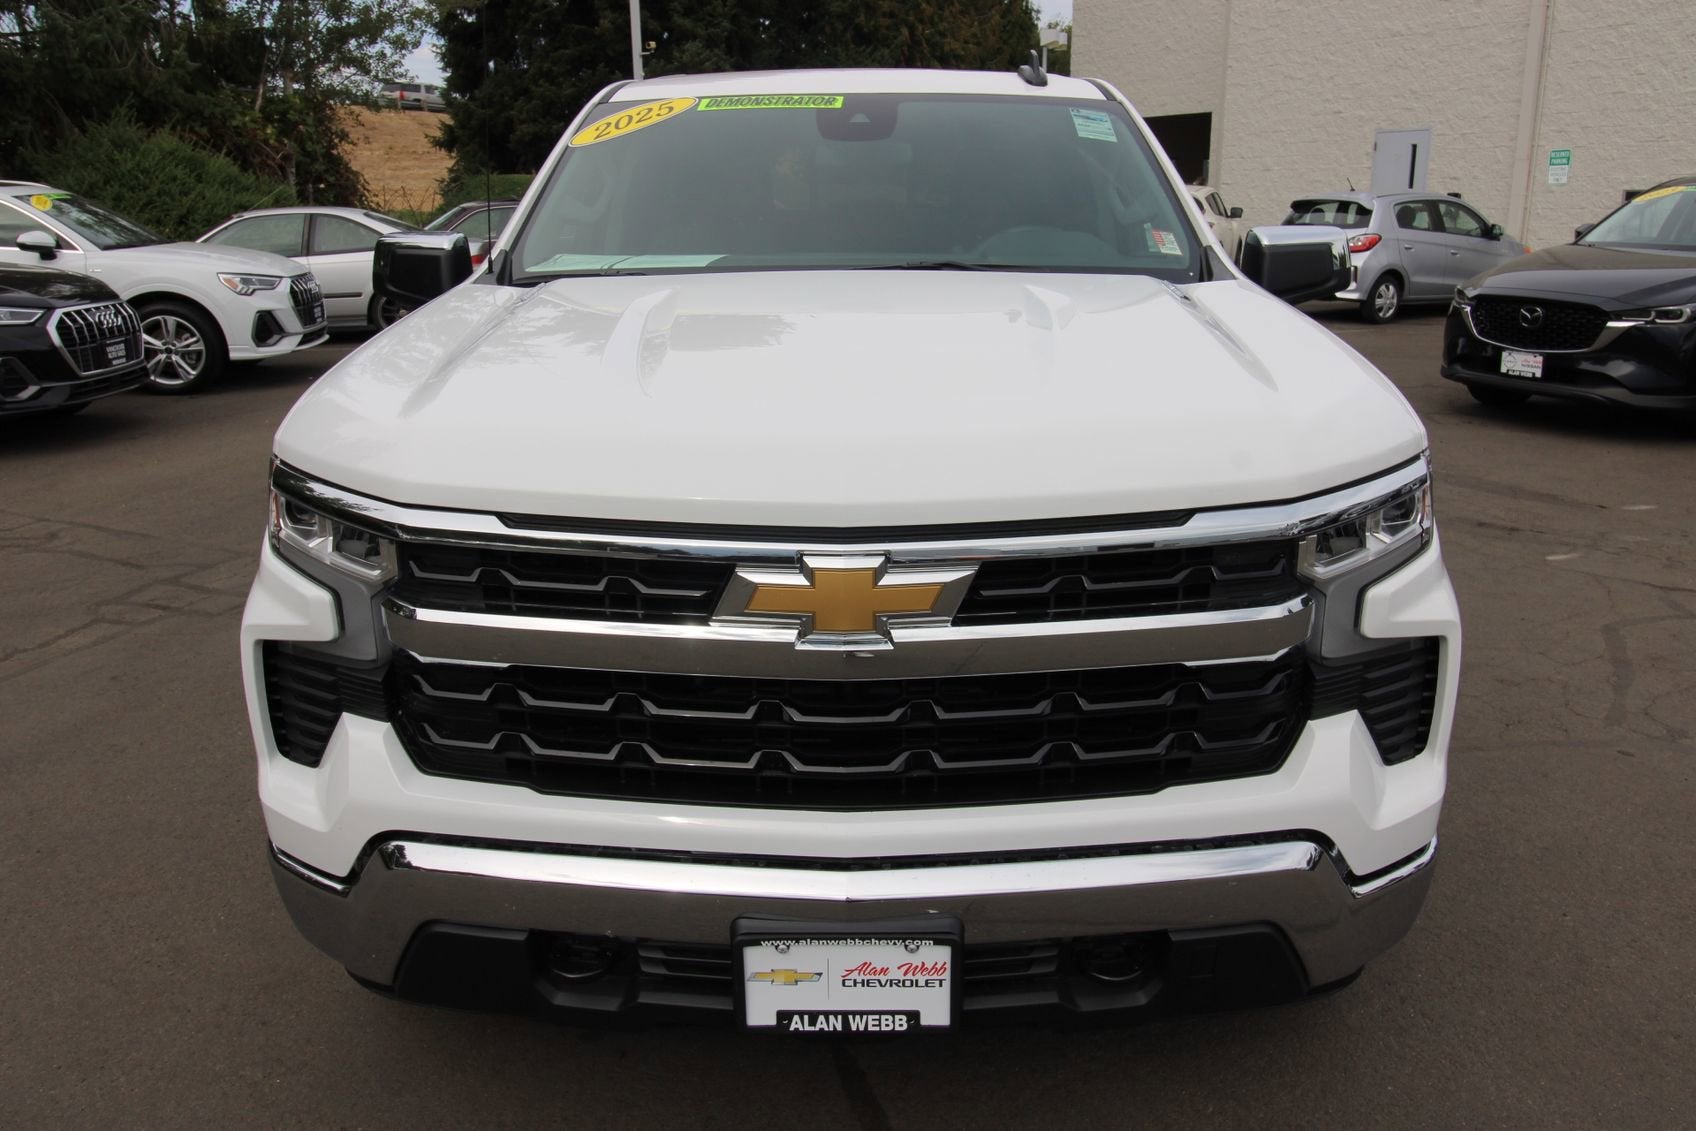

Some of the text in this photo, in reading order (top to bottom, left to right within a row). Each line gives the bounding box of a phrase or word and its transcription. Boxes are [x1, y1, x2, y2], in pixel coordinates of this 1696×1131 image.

[705, 96, 838, 108] DEMONSTRATOR
[593, 101, 676, 140] 2025
[760, 938, 934, 947] www.alanwebbchevy.com
[841, 961, 948, 977] Alan Webb
[841, 978, 947, 988] CHEVROLET
[789, 1015, 909, 1031] ALAN WEBB
